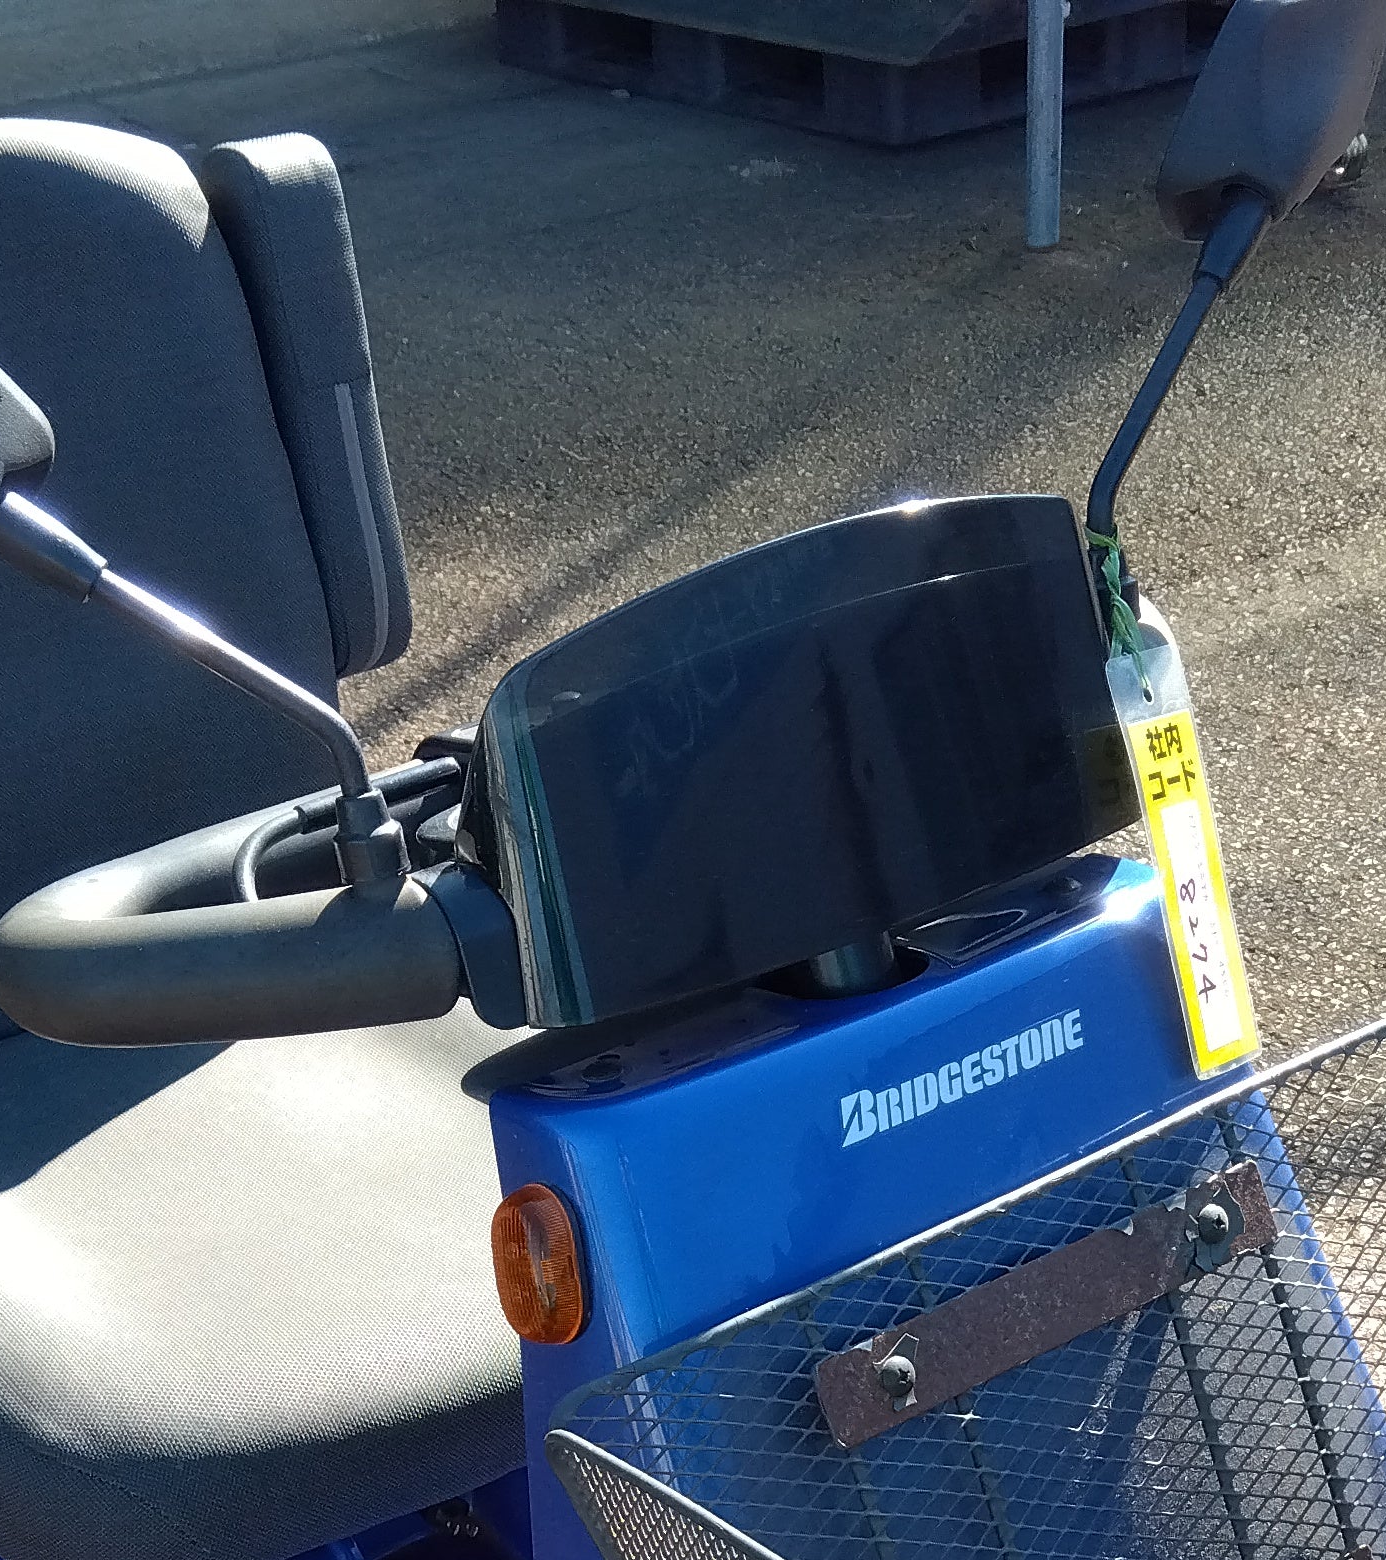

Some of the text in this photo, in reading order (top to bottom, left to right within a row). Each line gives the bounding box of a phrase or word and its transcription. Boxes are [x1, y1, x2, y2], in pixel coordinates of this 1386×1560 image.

[1146, 722, 1182, 761] 社内
[1148, 759, 1195, 801] コード
[840, 1008, 1083, 1148] BRIDGESTONE
